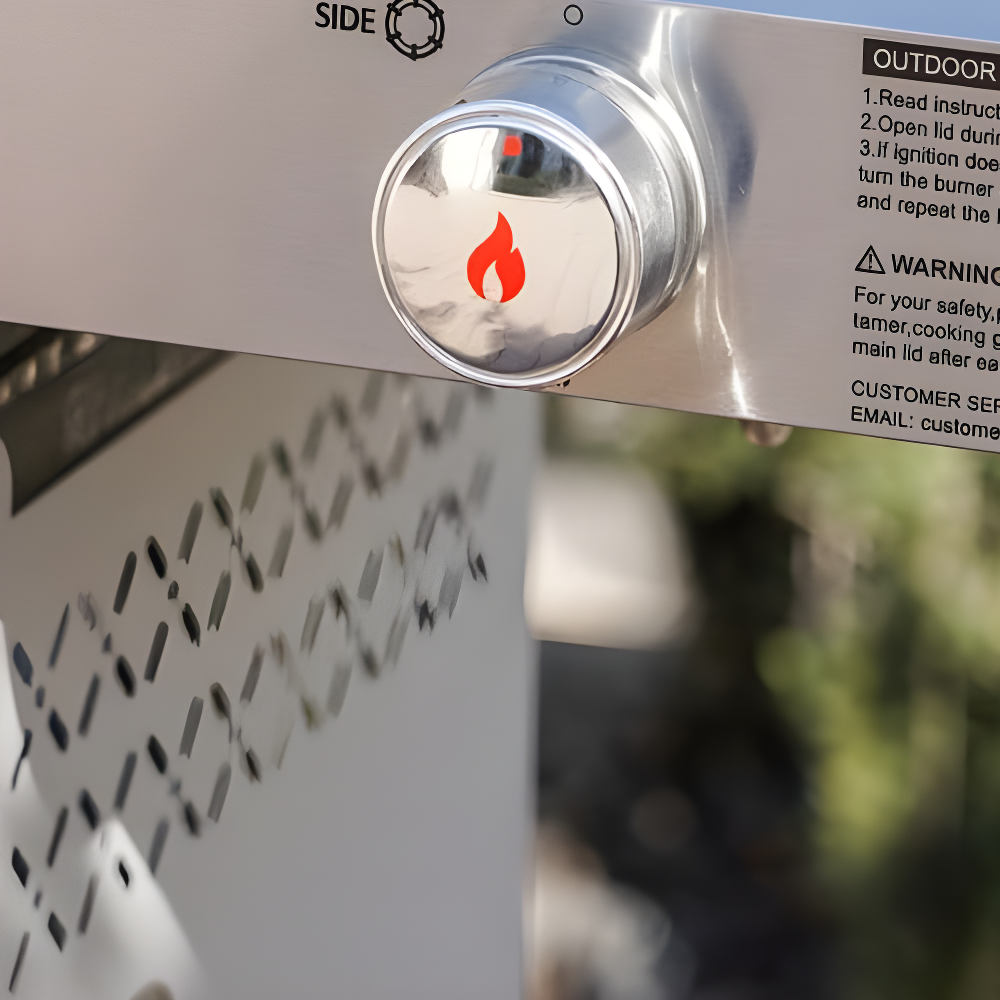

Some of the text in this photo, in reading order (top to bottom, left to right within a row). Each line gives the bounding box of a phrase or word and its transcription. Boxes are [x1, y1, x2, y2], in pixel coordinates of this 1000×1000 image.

[315, 2, 376, 34] SIDE
[872, 47, 998, 83] OUTDOOR
[863, 87, 928, 111] 1.Read
[860, 112, 928, 138] 2.Open
[933, 120, 954, 141] lid
[859, 138, 890, 159] 3.If
[893, 142, 959, 168] ignition
[858, 164, 893, 186] turn
[900, 170, 928, 190] the
[934, 173, 995, 198] burner
[856, 193, 892, 211] and
[897, 199, 956, 220] repeat
[962, 204, 991, 224] the
[854, 285, 887, 306] For
[890, 294, 932, 312] your
[852, 340, 896, 360] main
[902, 343, 923, 363] lid
[928, 348, 972, 368] after
[851, 379, 962, 409] CUSTOMER
[850, 405, 914, 429] EMAIL:
